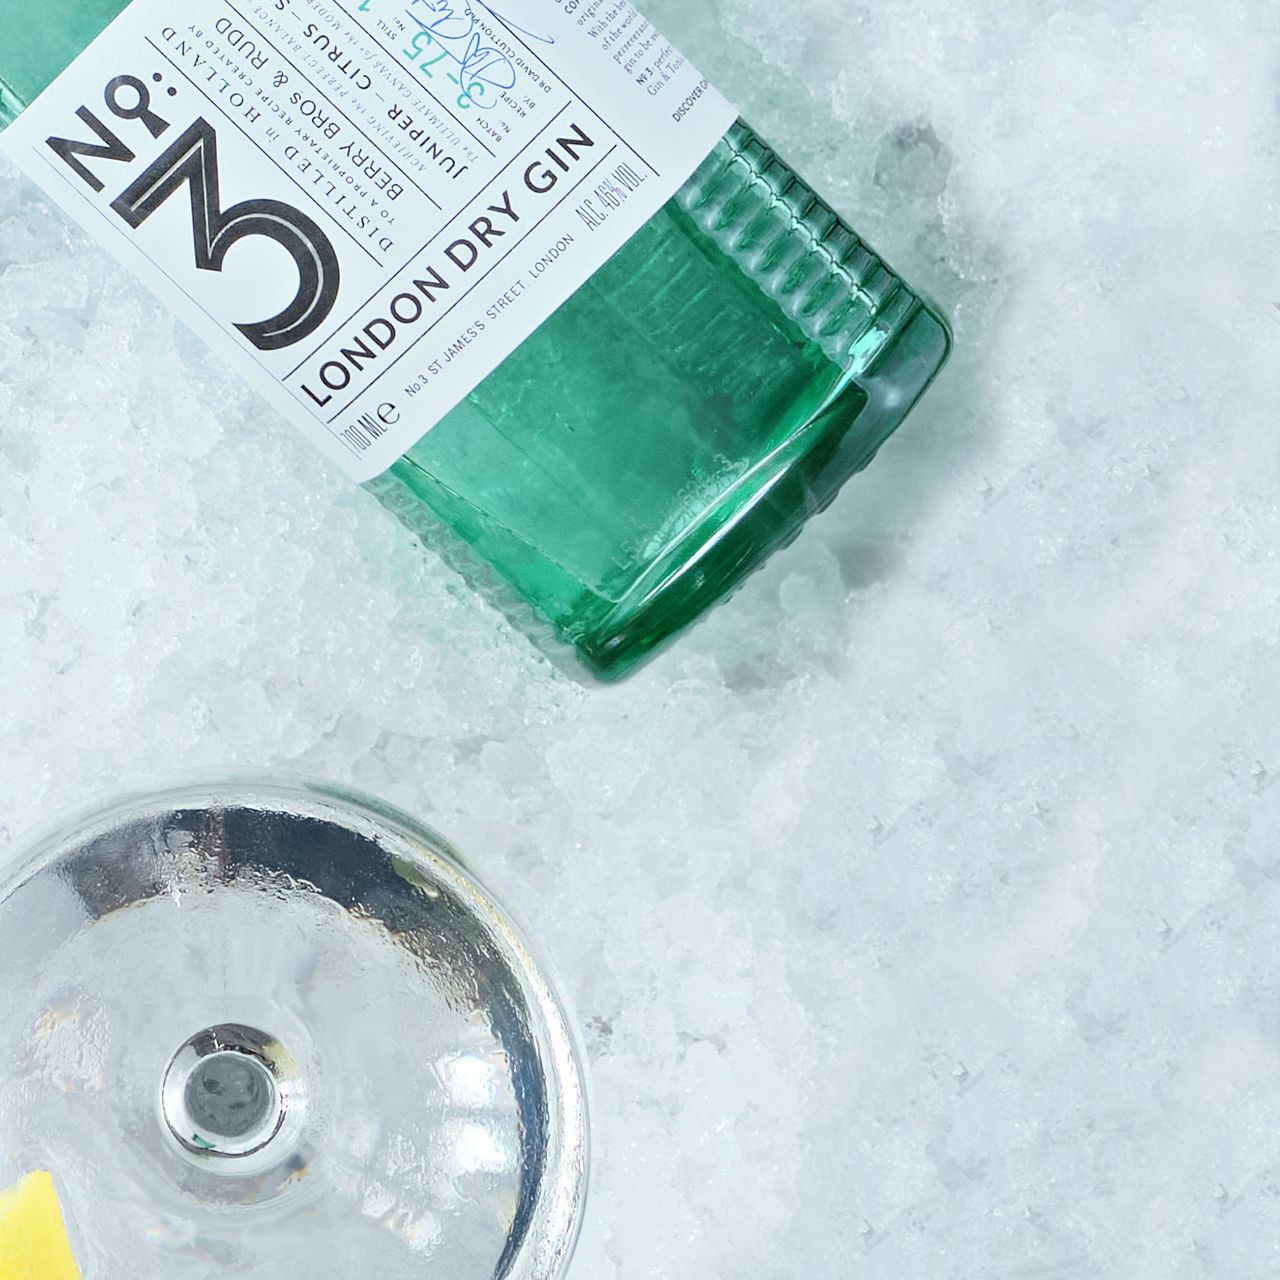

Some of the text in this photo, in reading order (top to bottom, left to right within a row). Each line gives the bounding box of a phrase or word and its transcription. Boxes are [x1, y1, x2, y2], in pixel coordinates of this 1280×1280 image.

[252, 5, 303, 53] BALANCE
[344, 31, 359, 46] the
[376, 19, 398, 41] STILL
[478, 22, 516, 59] CLUTTON
[587, 19, 609, 39] With
[605, 9, 619, 23] the
[601, 36, 612, 51] of
[608, 27, 623, 42] the
[215, 17, 269, 70] RUDD
[302, 23, 372, 90] CITRUS
[359, 47, 379, 61] for
[623, 39, 653, 75] gin to be
[272, 70, 289, 88] &
[300, 54, 350, 98] PERFECT
[372, 61, 412, 98] CANVAS
[515, 57, 540, 82] DAVID
[538, 79, 552, 94] DR
[646, 80, 665, 96] Gin
[660, 71, 671, 82] &
[351, 98, 367, 114] the
[411, 98, 461, 147] ULTIMATE
[499, 90, 527, 118] RECIPE
[671, 85, 704, 123] DISCOVER
[161, 27, 394, 253] DISTILLED in HOLLAND
[187, 24, 395, 226] TO A PROPRIETARY RECIPE CREATED BY
[387, 103, 469, 180] JUNIPER
[475, 116, 502, 143] BATCH
[366, 116, 428, 172] ACHIEVING
[462, 146, 479, 164] The
[338, 141, 404, 201] BERRY
[574, 161, 648, 232] ALC. 46% VOL.
[108, 115, 341, 352] 3
[300, 122, 595, 408] LONDON DRY GIN
[404, 374, 429, 397] No.3
[427, 358, 443, 375] ST
[528, 233, 575, 279] LONDON
